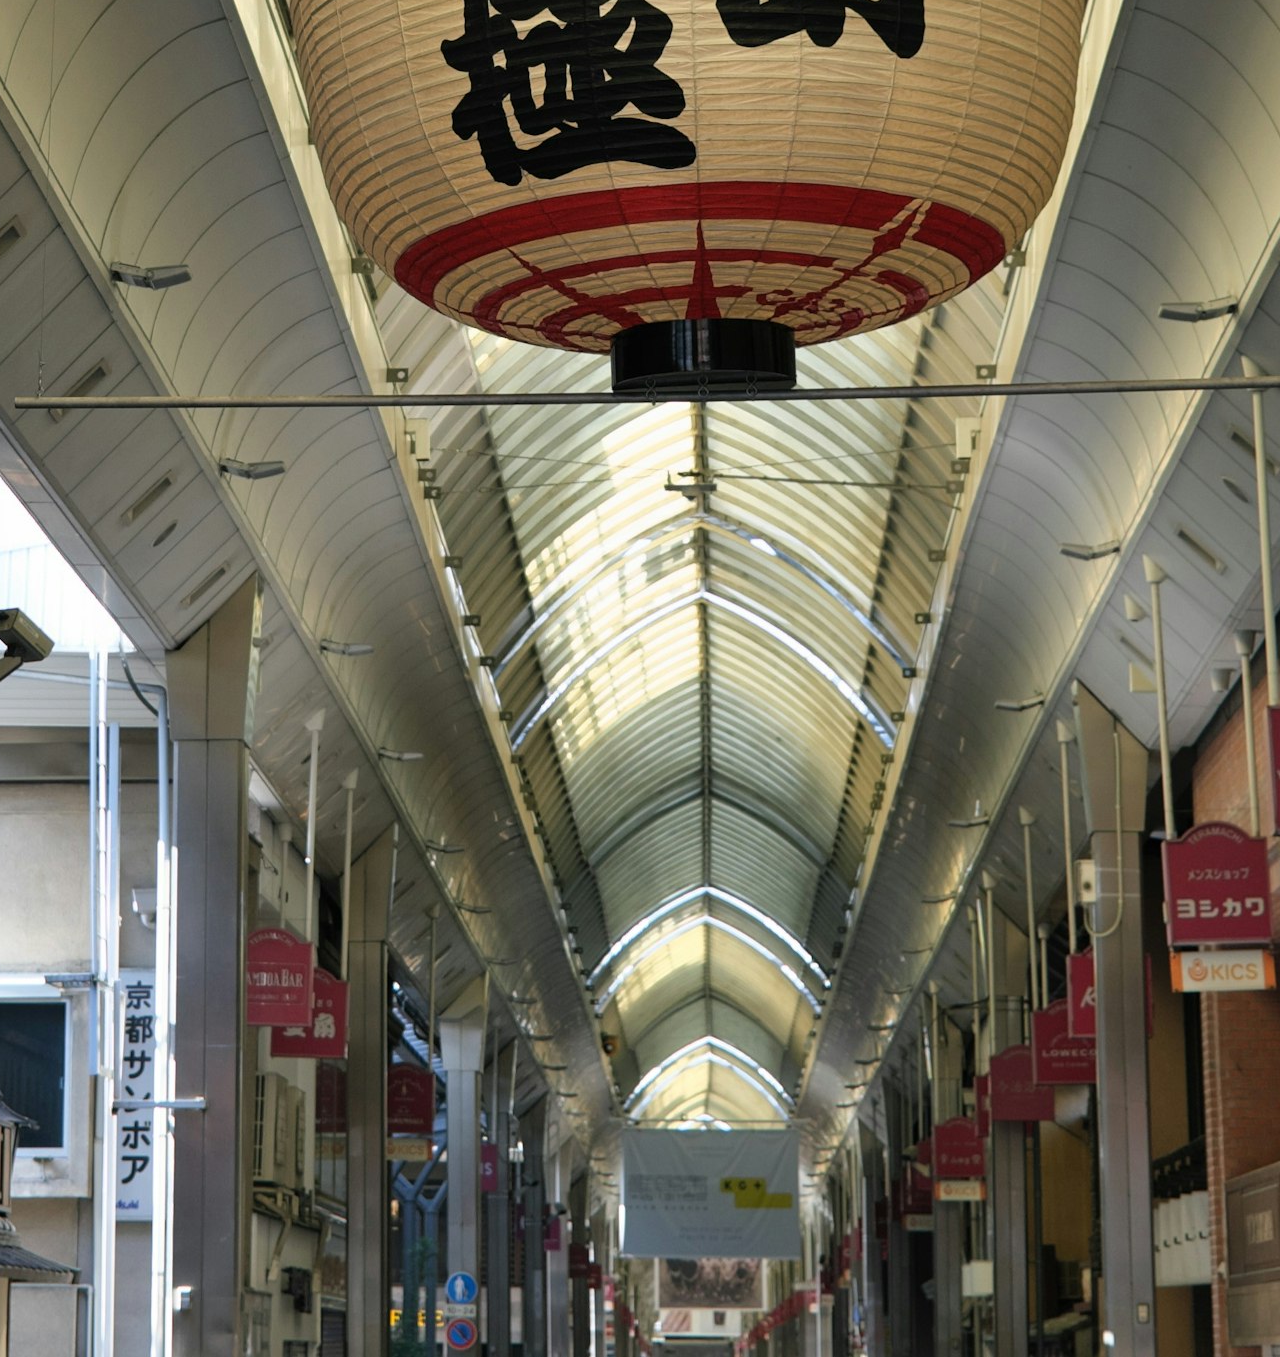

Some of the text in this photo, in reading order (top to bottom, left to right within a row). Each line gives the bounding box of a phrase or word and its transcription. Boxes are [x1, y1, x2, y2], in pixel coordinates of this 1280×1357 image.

[1188, 825, 1244, 845] TERAMACHI
[1176, 897, 1266, 919] ヨシカワ
[1211, 962, 1258, 981] KICS
[120, 980, 154, 1185] 京都サンボア
